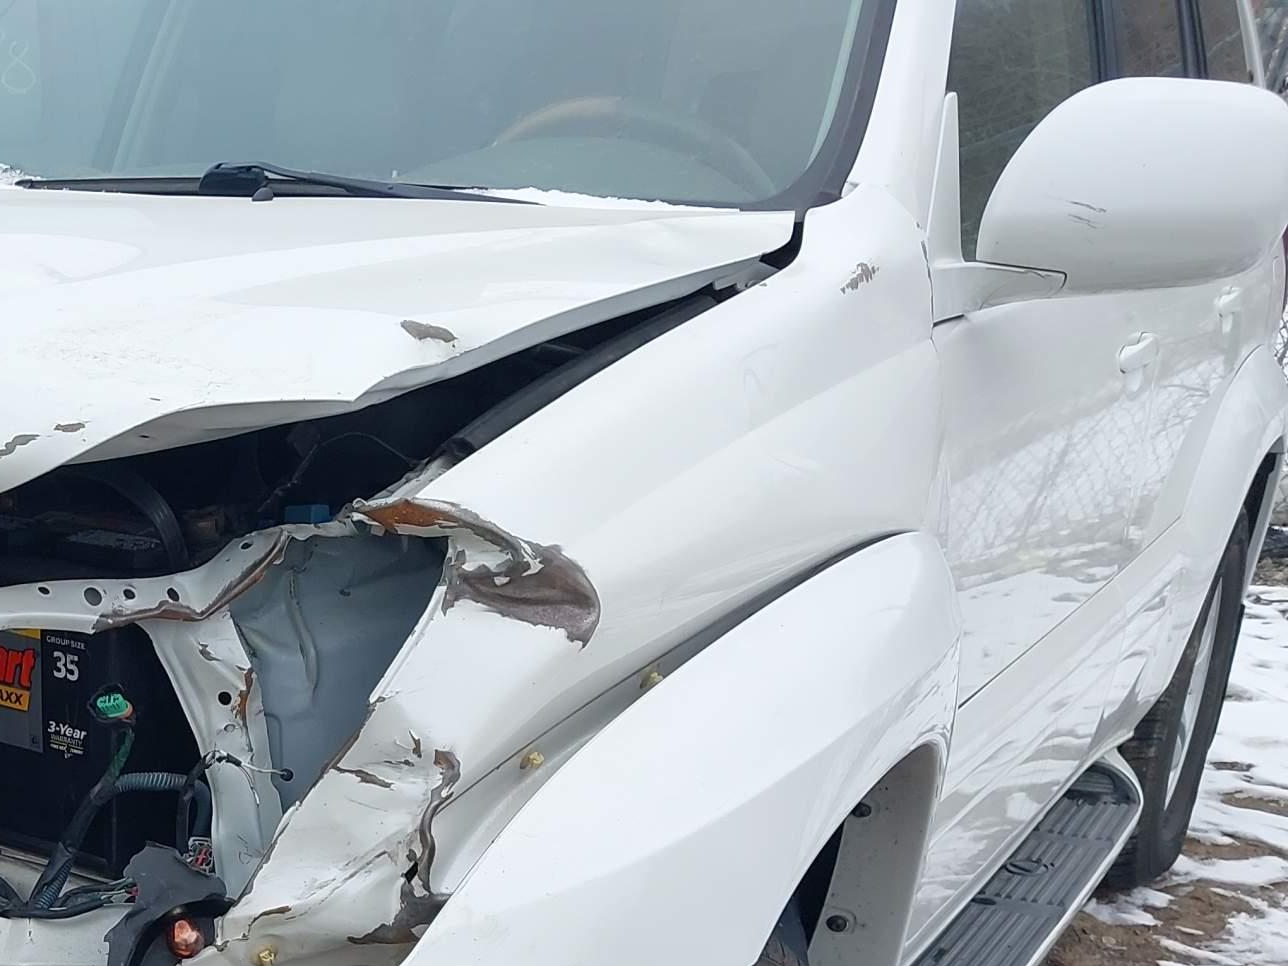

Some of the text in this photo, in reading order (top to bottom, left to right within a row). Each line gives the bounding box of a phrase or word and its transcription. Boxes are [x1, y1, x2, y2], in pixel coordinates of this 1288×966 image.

[70, 639, 87, 650] SIZE
[53, 651, 79, 680] 35
[47, 720, 87, 740] 3-Year
